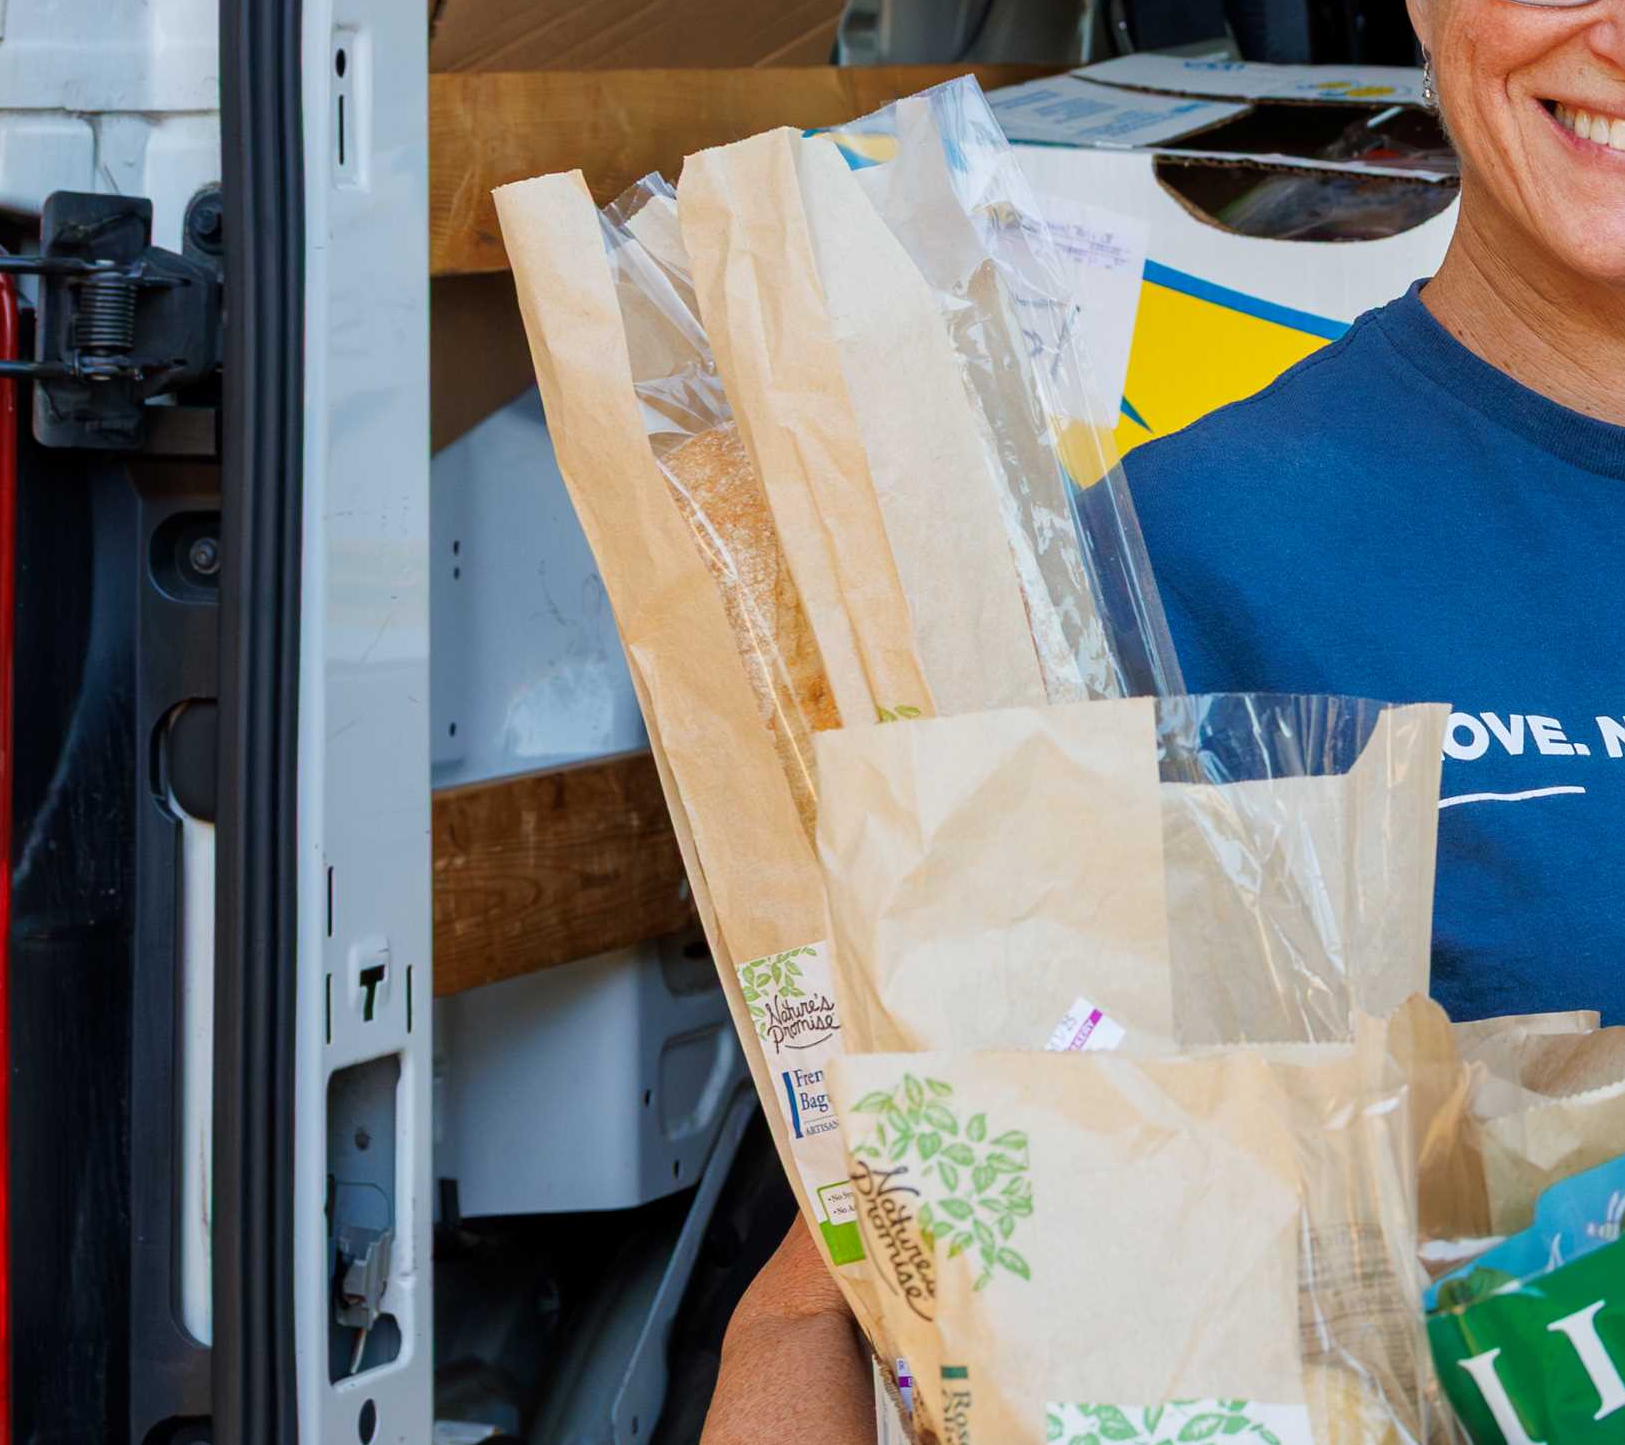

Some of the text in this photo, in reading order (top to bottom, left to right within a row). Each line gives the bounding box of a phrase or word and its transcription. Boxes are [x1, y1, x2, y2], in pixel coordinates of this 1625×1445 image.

[1441, 712, 1590, 761] OVE.
[765, 993, 835, 1026] Nature's
[767, 1013, 840, 1053] Promise
[794, 1069, 825, 1088] Fren
